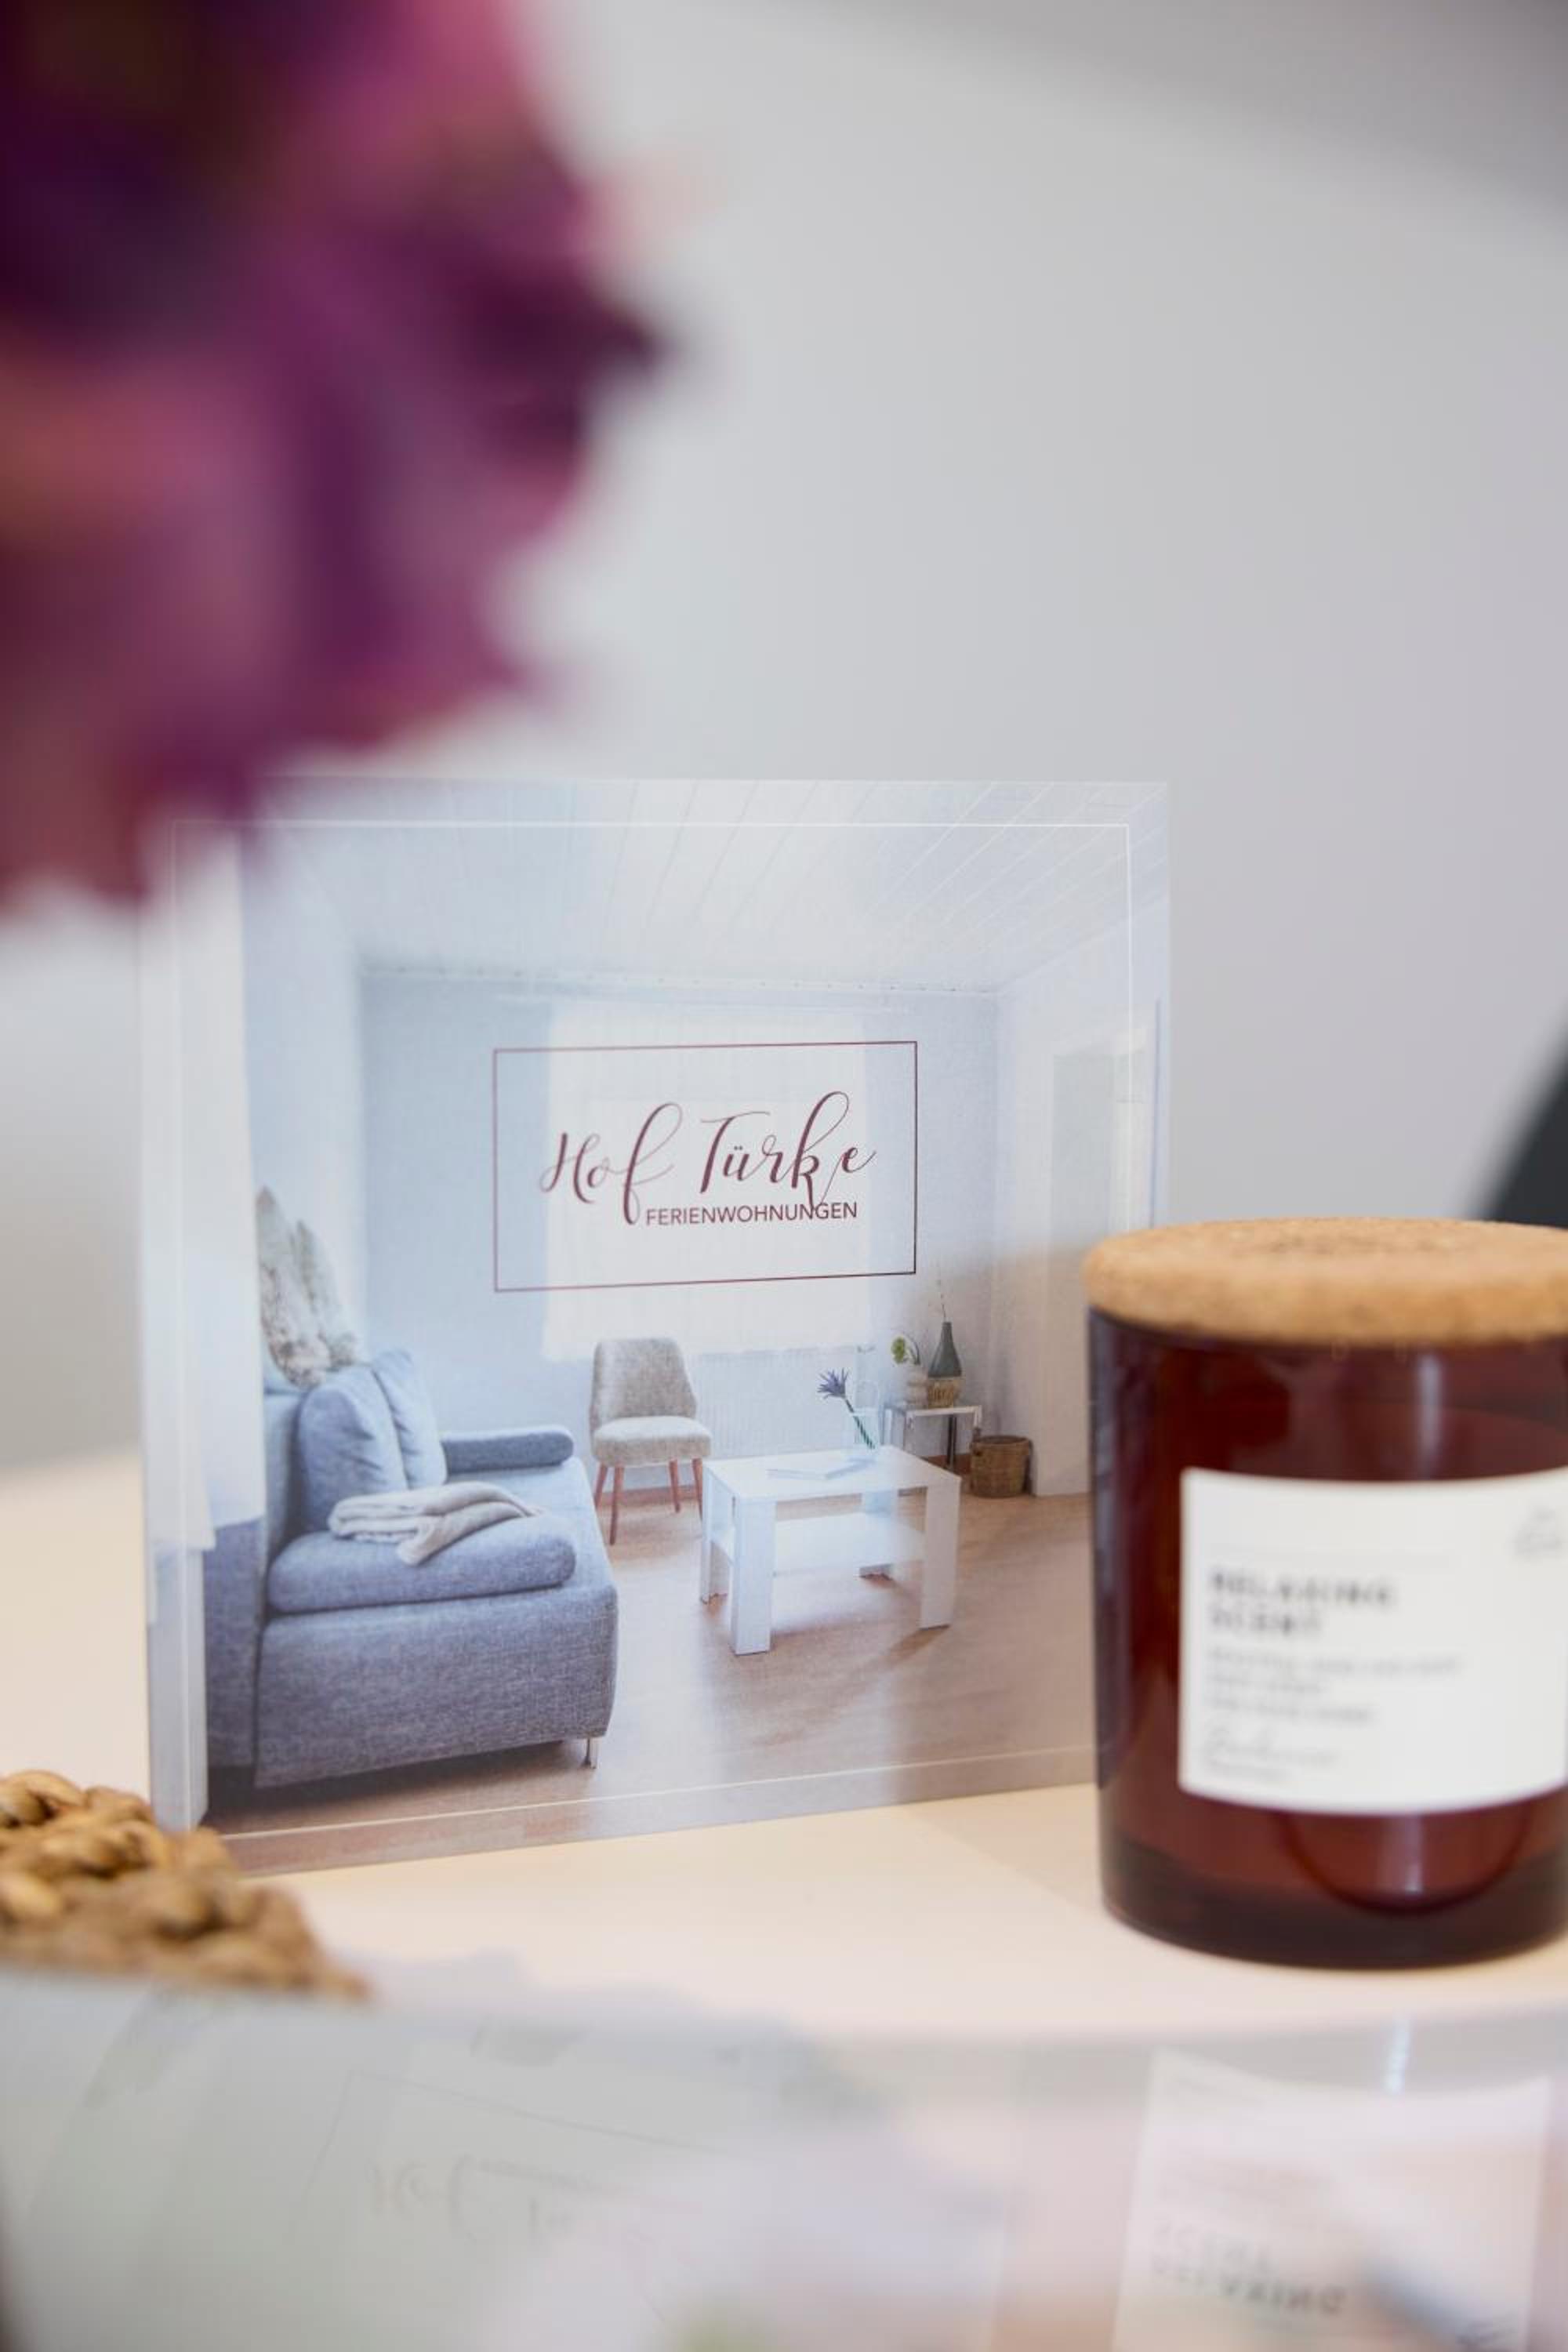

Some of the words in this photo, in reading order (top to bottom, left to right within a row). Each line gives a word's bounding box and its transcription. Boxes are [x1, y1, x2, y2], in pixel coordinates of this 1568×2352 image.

[539, 1102, 683, 1225] Hof
[700, 1091, 877, 1211] Türke
[645, 1201, 858, 1226] FERIENWOHNUNGEN
[1210, 1568, 1396, 1606] RELAXING
